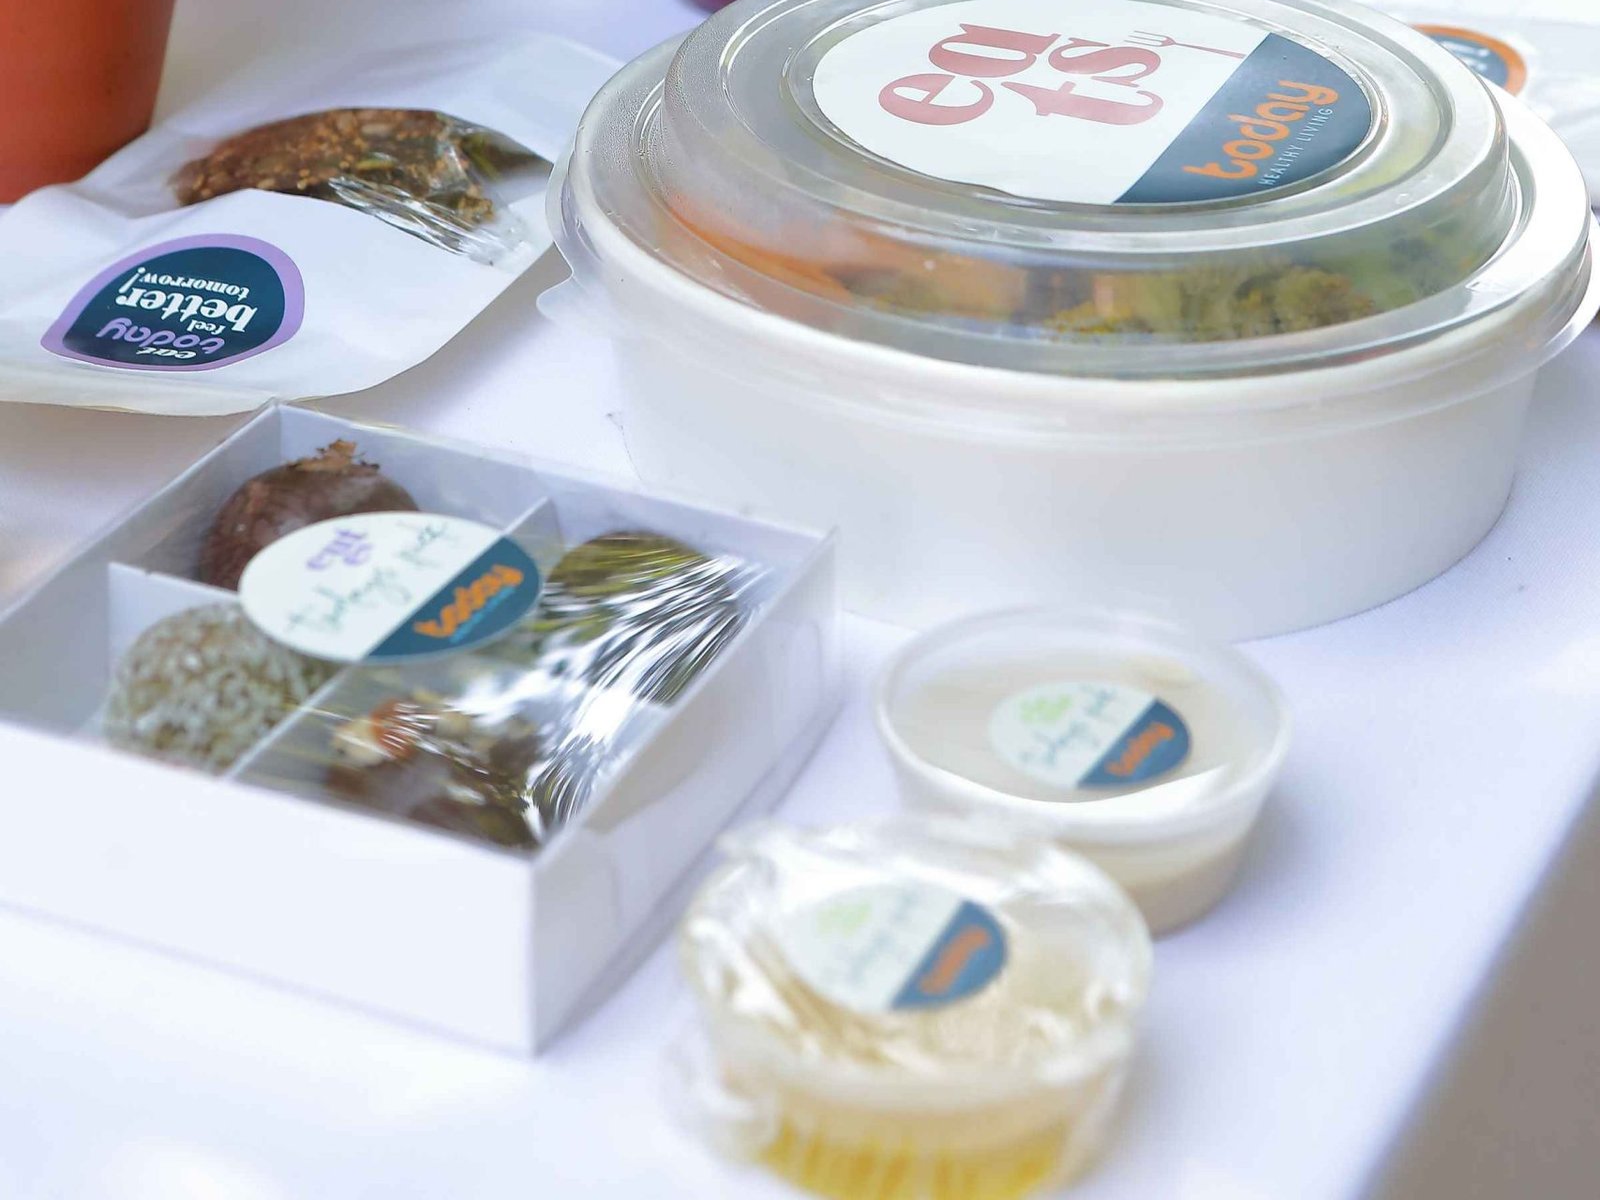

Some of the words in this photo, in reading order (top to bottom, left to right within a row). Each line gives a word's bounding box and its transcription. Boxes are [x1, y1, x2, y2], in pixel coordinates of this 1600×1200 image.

[1183, 80, 1338, 179] today
[1259, 144, 1303, 185] HEALTHY
[1297, 108, 1333, 142] LIVING
[115, 287, 258, 332] better
[186, 319, 226, 335] feel
[96, 317, 225, 354] today
[136, 347, 196, 358] eat
